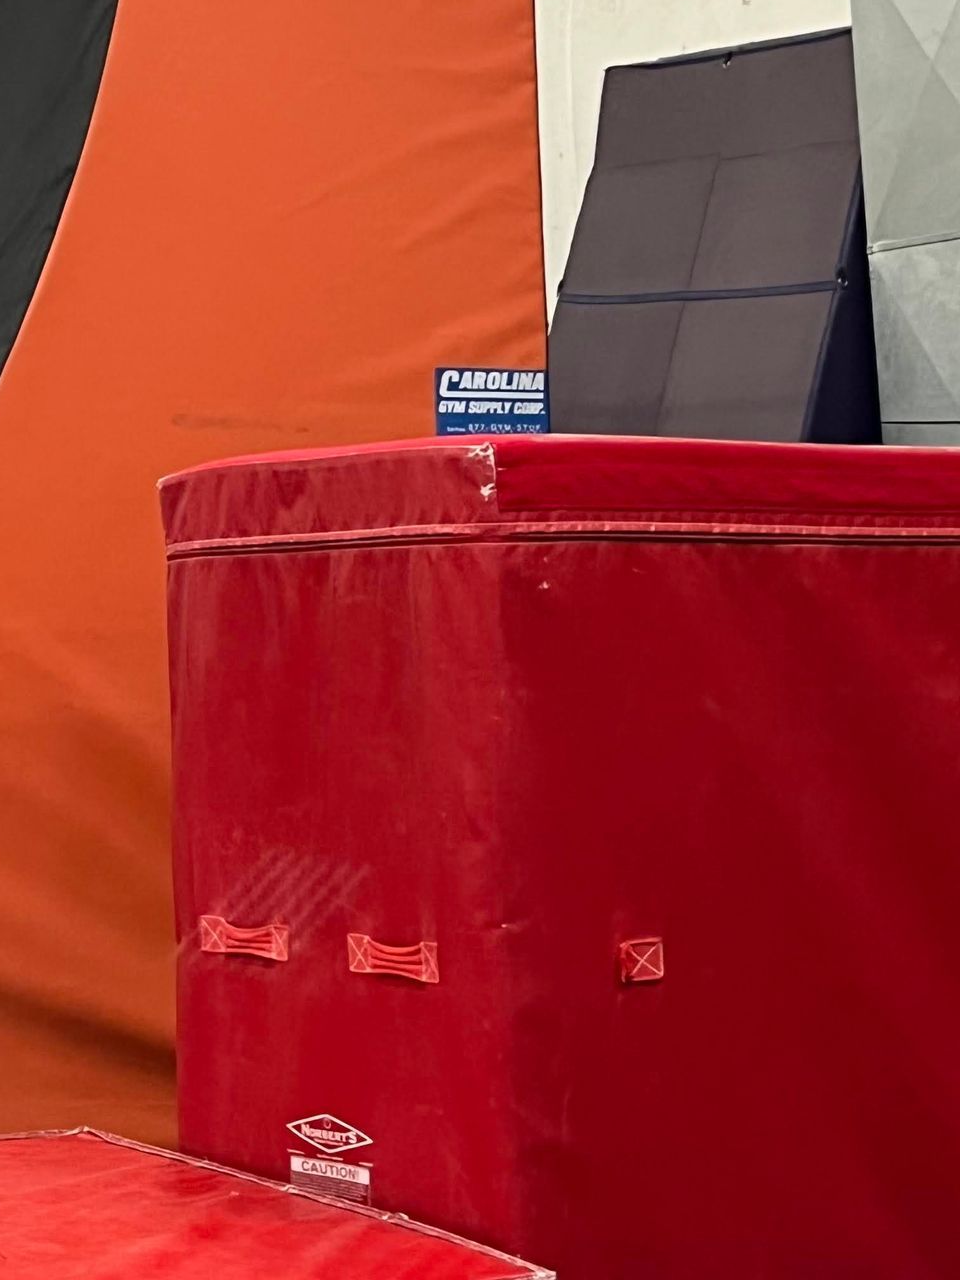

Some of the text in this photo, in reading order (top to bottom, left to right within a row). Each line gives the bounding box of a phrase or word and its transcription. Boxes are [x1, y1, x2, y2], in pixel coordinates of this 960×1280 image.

[439, 370, 545, 397] CAROLINA
[439, 400, 466, 413] GYM
[468, 401, 512, 414] SUPPLY
